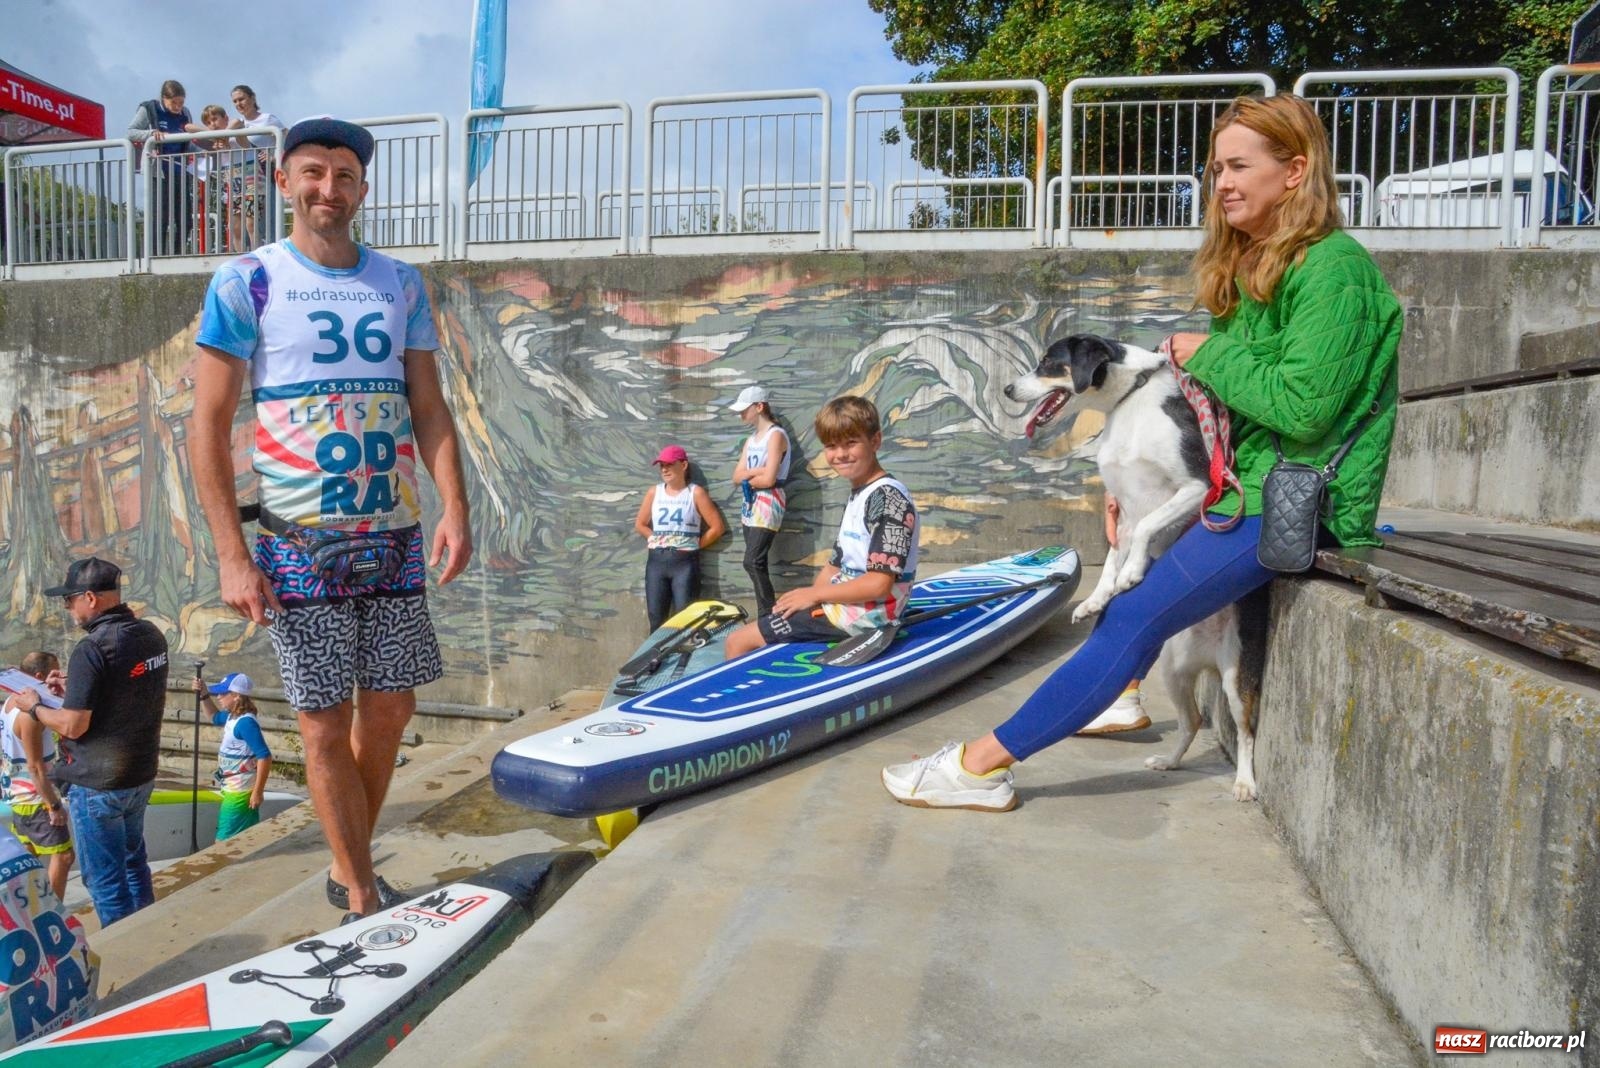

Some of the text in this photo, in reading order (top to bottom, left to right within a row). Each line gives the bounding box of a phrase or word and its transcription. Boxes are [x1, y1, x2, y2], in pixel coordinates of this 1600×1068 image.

[286, 287, 395, 305] #odrasupcup
[307, 310, 392, 364] 36
[315, 382, 399, 393] 1-3.09.2023
[289, 402, 367, 424] LET'S
[657, 507, 684, 526] 24
[648, 739, 765, 794] CHAMPION
